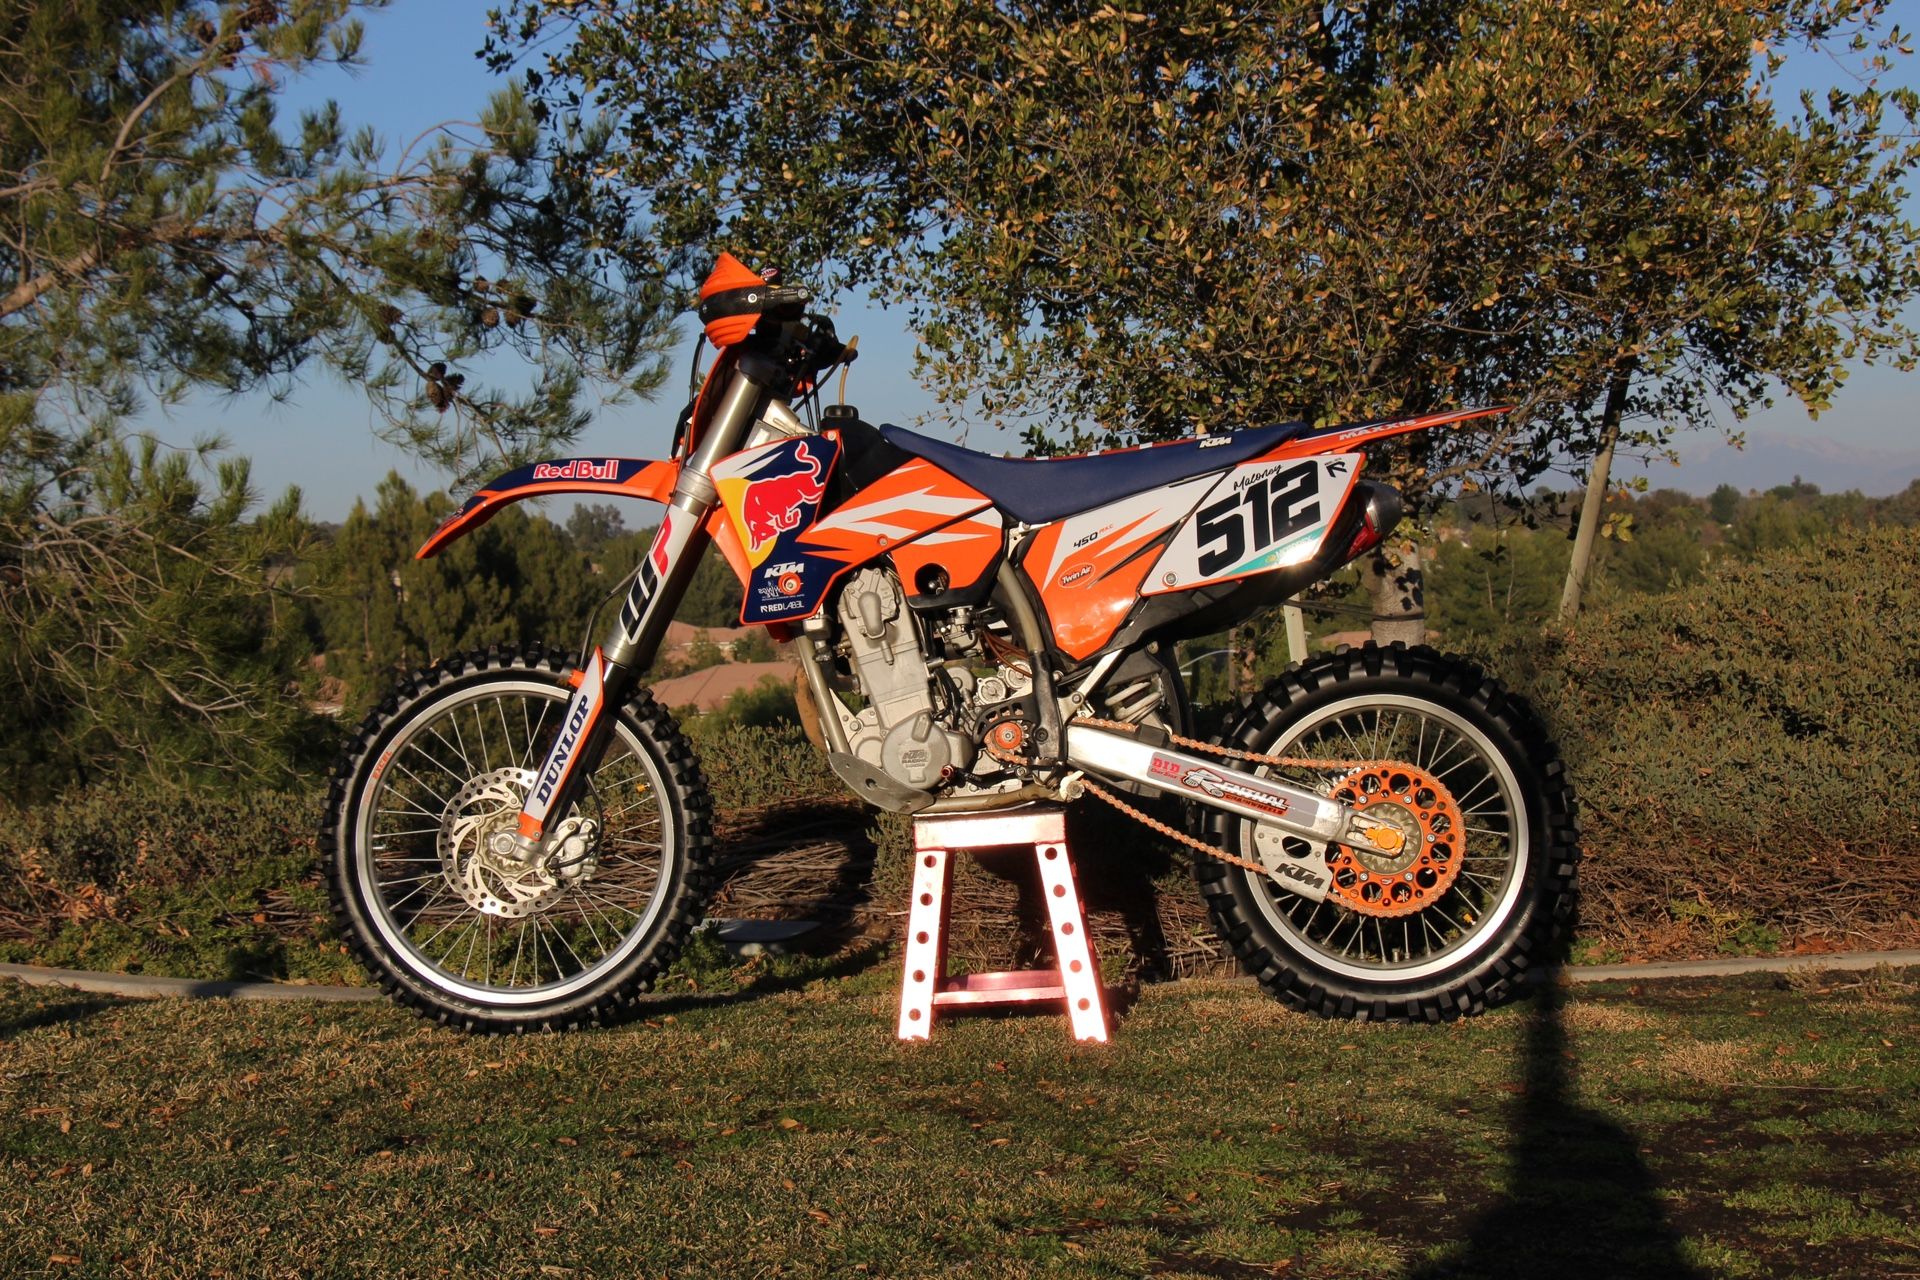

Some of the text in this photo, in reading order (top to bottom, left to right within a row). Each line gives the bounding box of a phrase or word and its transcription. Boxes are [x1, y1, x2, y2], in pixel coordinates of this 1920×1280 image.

[1339, 418, 1417, 441] MAXXIS
[1199, 437, 1231, 449] KTM
[533, 460, 618, 480] Red Bull
[1196, 460, 1321, 577] 512
[1073, 531, 1098, 548] 450
[764, 562, 805, 578] KTM
[1062, 565, 1092, 586] Twin Air
[536, 694, 589, 807] DUNLOP
[1275, 863, 1324, 889] KTM
